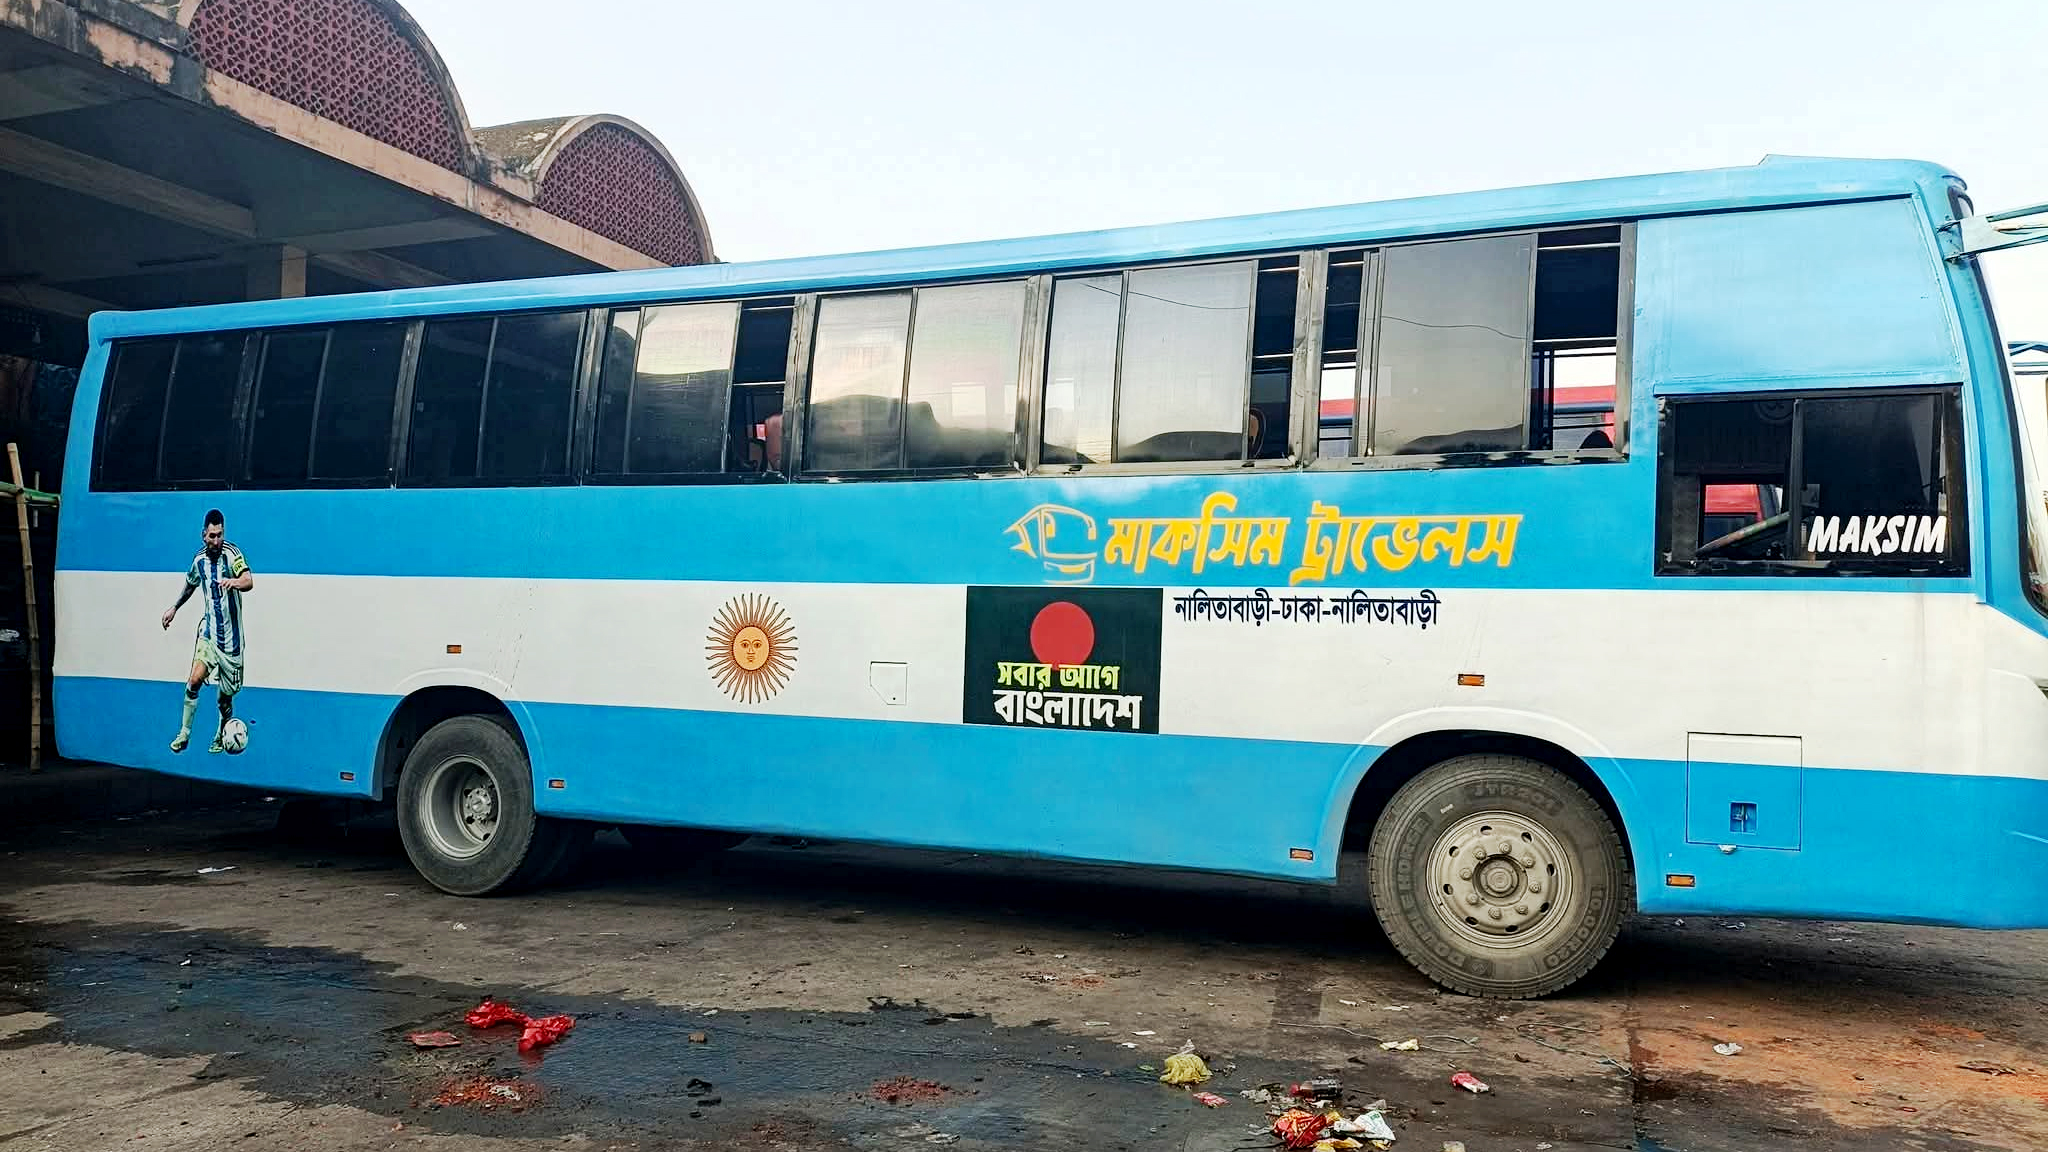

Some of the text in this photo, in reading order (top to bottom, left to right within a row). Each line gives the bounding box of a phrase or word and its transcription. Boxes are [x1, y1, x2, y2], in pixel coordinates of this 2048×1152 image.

[1104, 491, 1523, 586] মাকসিম ট্রাভেলস
[1807, 515, 1948, 556] MAKSIM
[997, 661, 1121, 690] সবার আগে
[993, 689, 1143, 730] বাংলাদেশ
